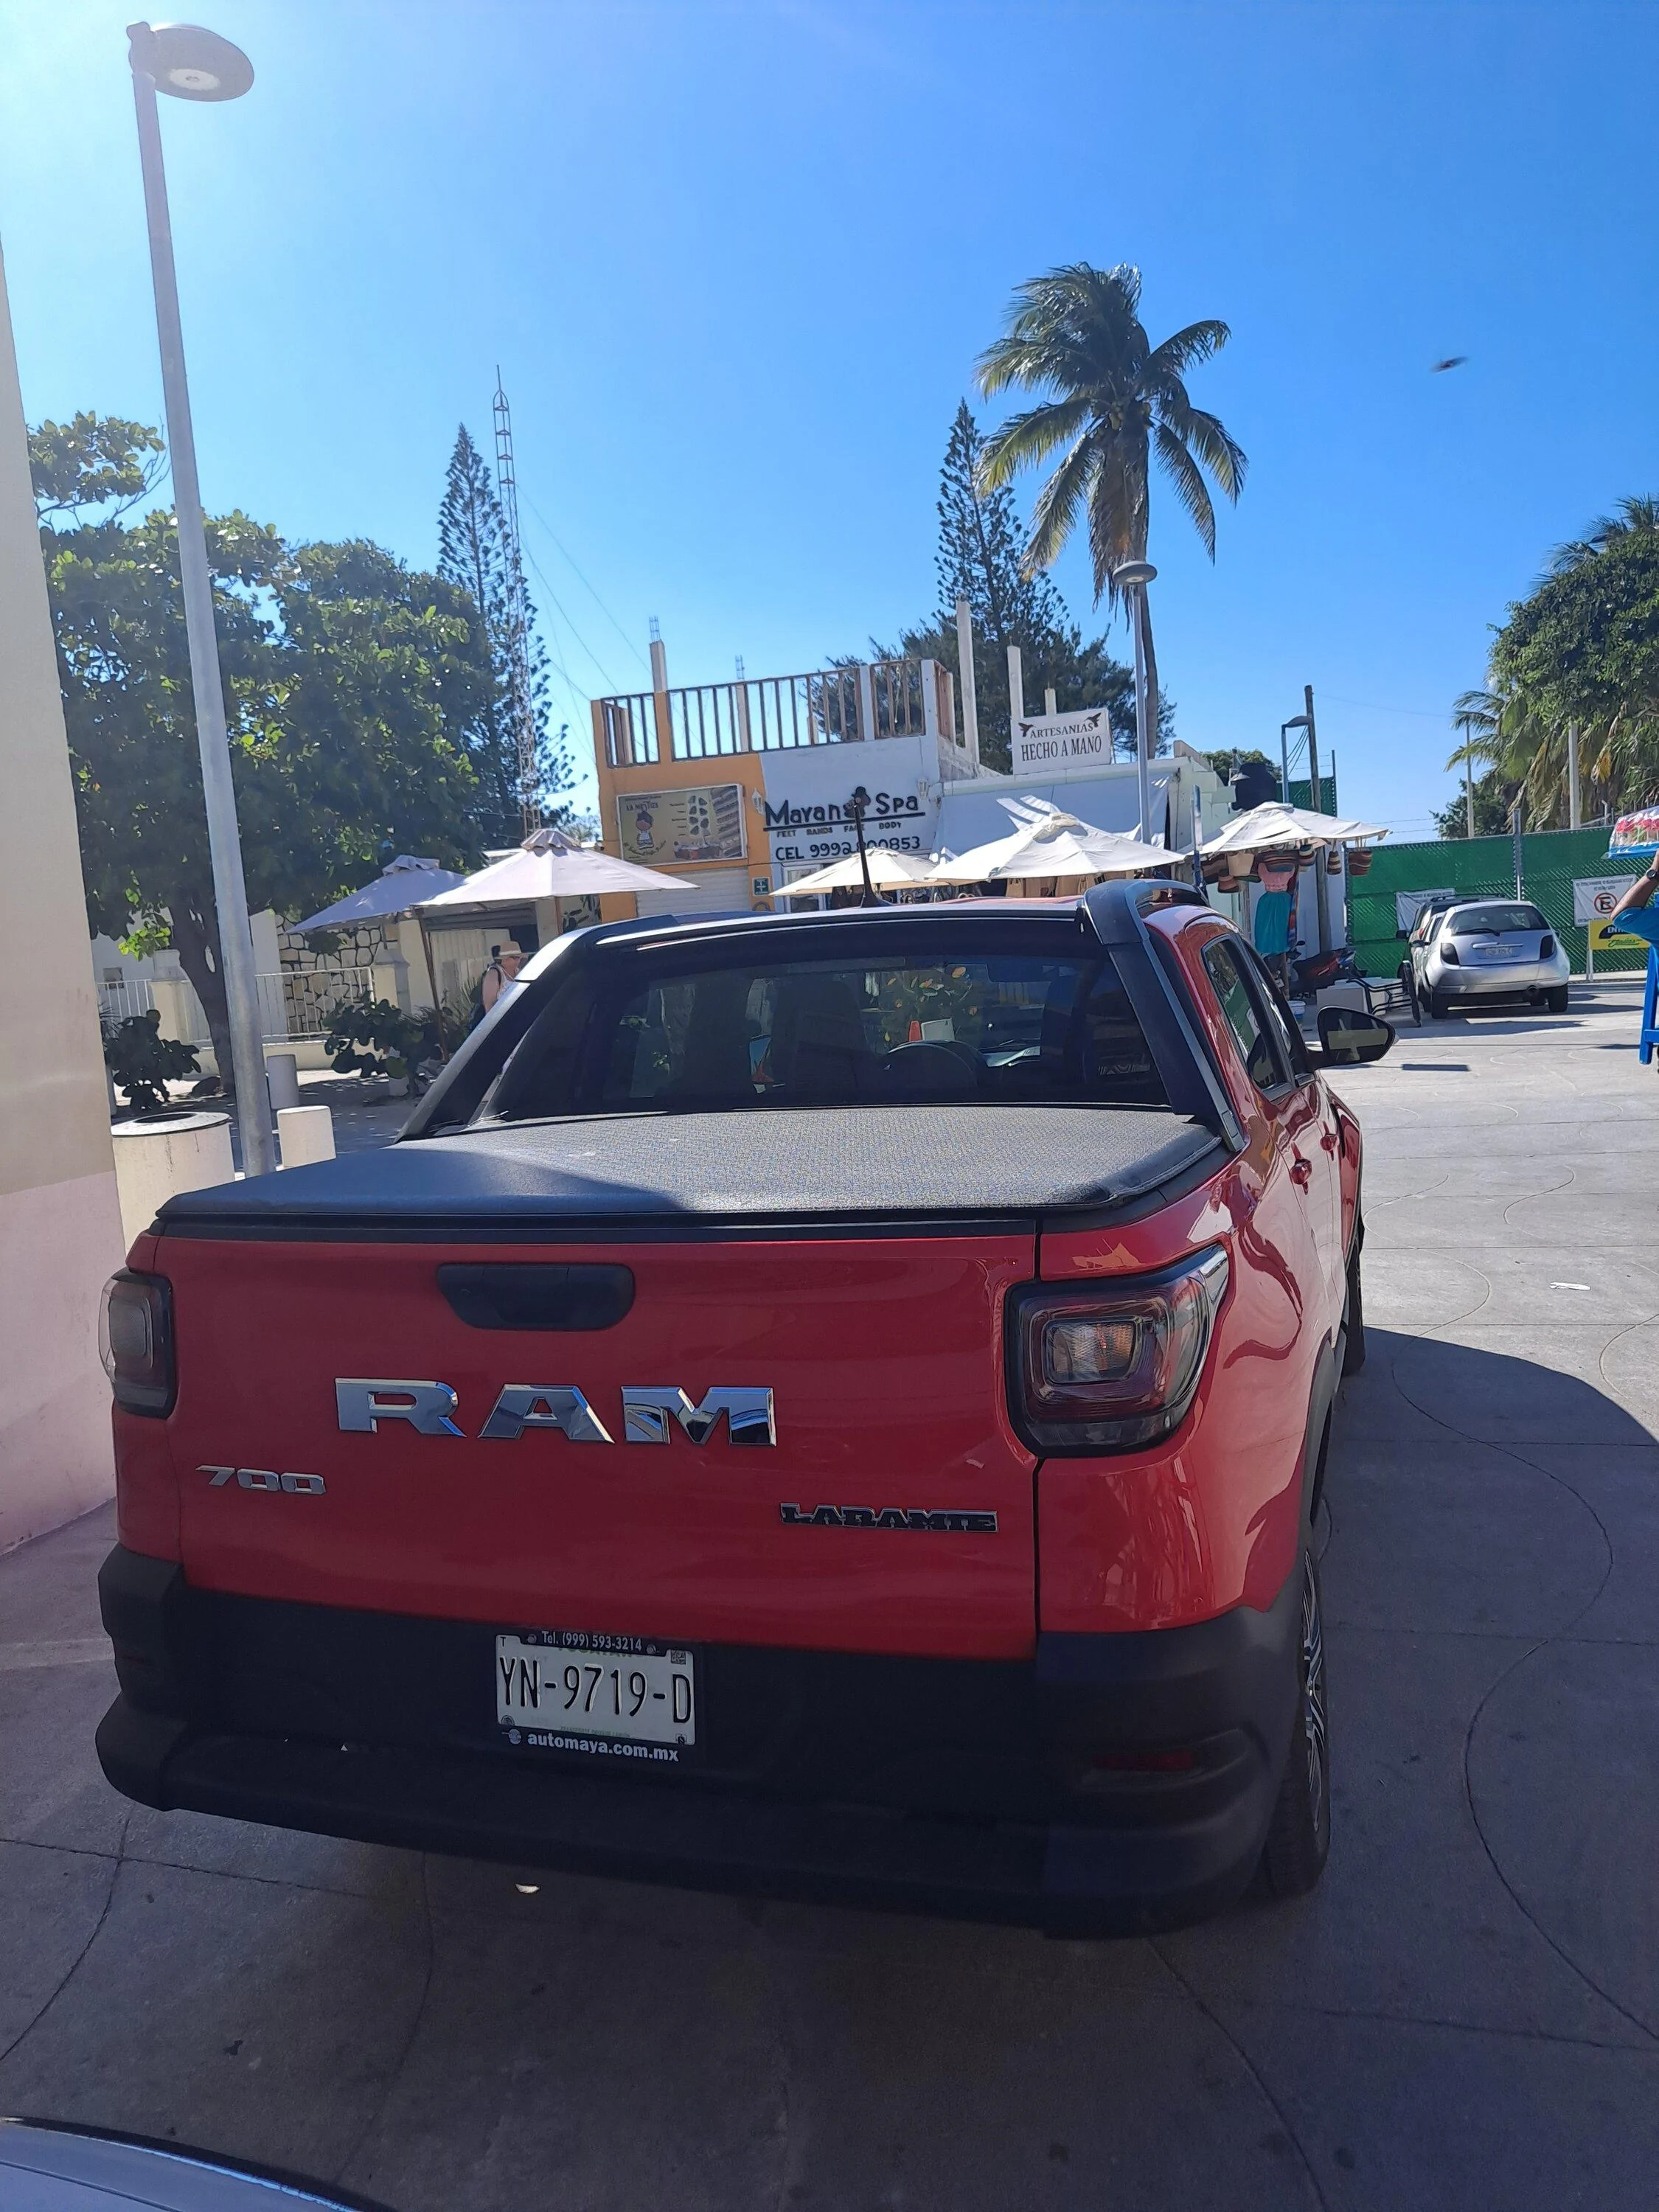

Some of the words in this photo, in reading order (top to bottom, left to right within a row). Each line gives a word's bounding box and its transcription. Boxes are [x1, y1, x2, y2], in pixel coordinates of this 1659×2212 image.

[1030, 723, 1093, 739] ARTESANIAS
[1021, 741, 1058, 762] HECHO
[1062, 740, 1068, 757] A
[1071, 736, 1102, 756] MANO
[875, 793, 919, 815] Spa
[844, 824, 866, 833] FAE
[776, 846, 804, 861] CEL
[334, 1377, 777, 1447] RAM
[195, 1464, 327, 1495] 700
[780, 1502, 998, 1532] LARAMIE
[541, 1630, 559, 1645] Tel.
[562, 1632, 589, 1649] (999)
[591, 1634, 642, 1652] 593-3214
[499, 1656, 692, 1724] YN-9719-D
[527, 1731, 680, 1762] automaya.com.mx
